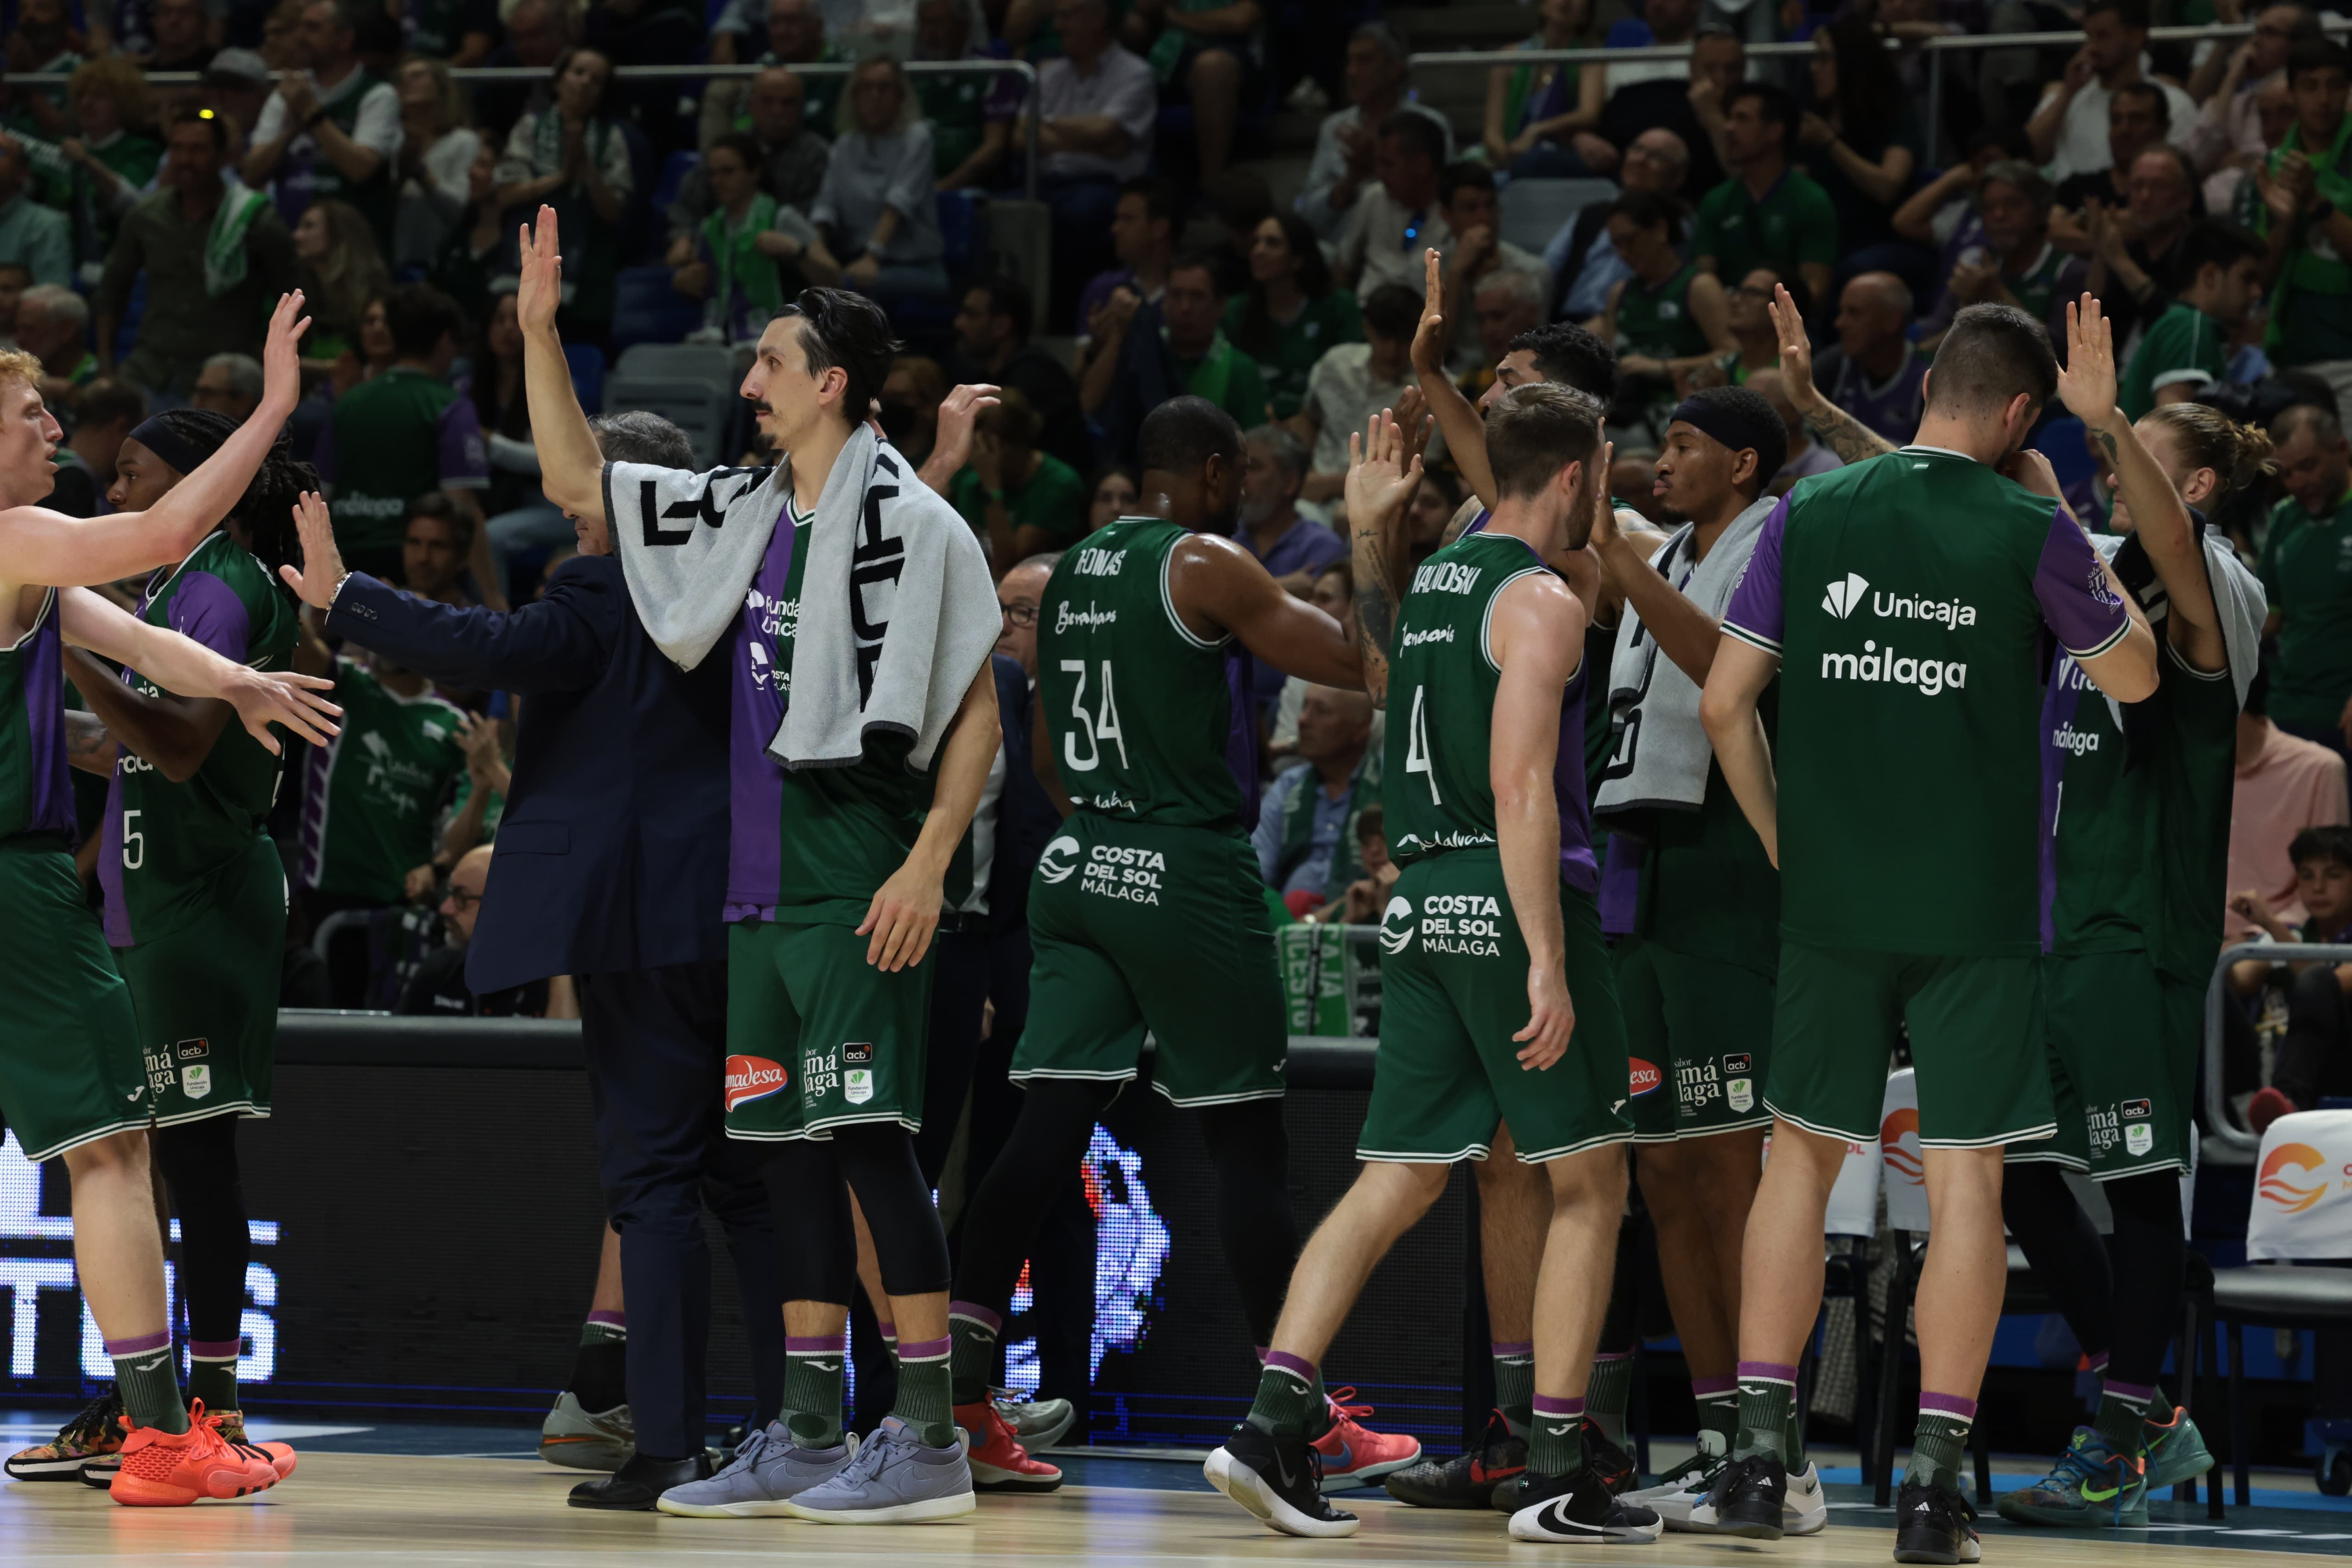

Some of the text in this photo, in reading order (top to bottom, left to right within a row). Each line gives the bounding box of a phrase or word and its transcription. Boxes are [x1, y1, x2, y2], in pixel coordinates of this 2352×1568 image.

[766, 595, 800, 617] Funda
[1873, 591, 1976, 631] Unicaja
[761, 615, 797, 638] Unica
[771, 670, 790, 681] OSTA
[1060, 659, 1129, 771] 34
[1406, 685, 1442, 805] 4
[123, 809, 144, 870] 5
[1091, 845, 1165, 872] COSTA
[1084, 862, 1162, 889] DEL SOL
[1081, 877, 1159, 906] MÁLAGA
[1424, 895, 1501, 917] COSTA
[1422, 919, 1501, 937] DEL SOL
[1422, 935, 1500, 957] MÁLAGA
[181, 1047, 202, 1057] acb
[806, 1046, 839, 1076] má
[847, 1050, 866, 1060] acb
[1674, 1058, 1692, 1067] sabor
[1680, 1056, 1720, 1085] má
[1727, 1060, 1746, 1070] acb
[1677, 1080, 1722, 1106] laga
[2090, 1103, 2120, 1130] má
[2125, 1106, 2144, 1116] acb
[1847, 1143, 1866, 1155] OL
